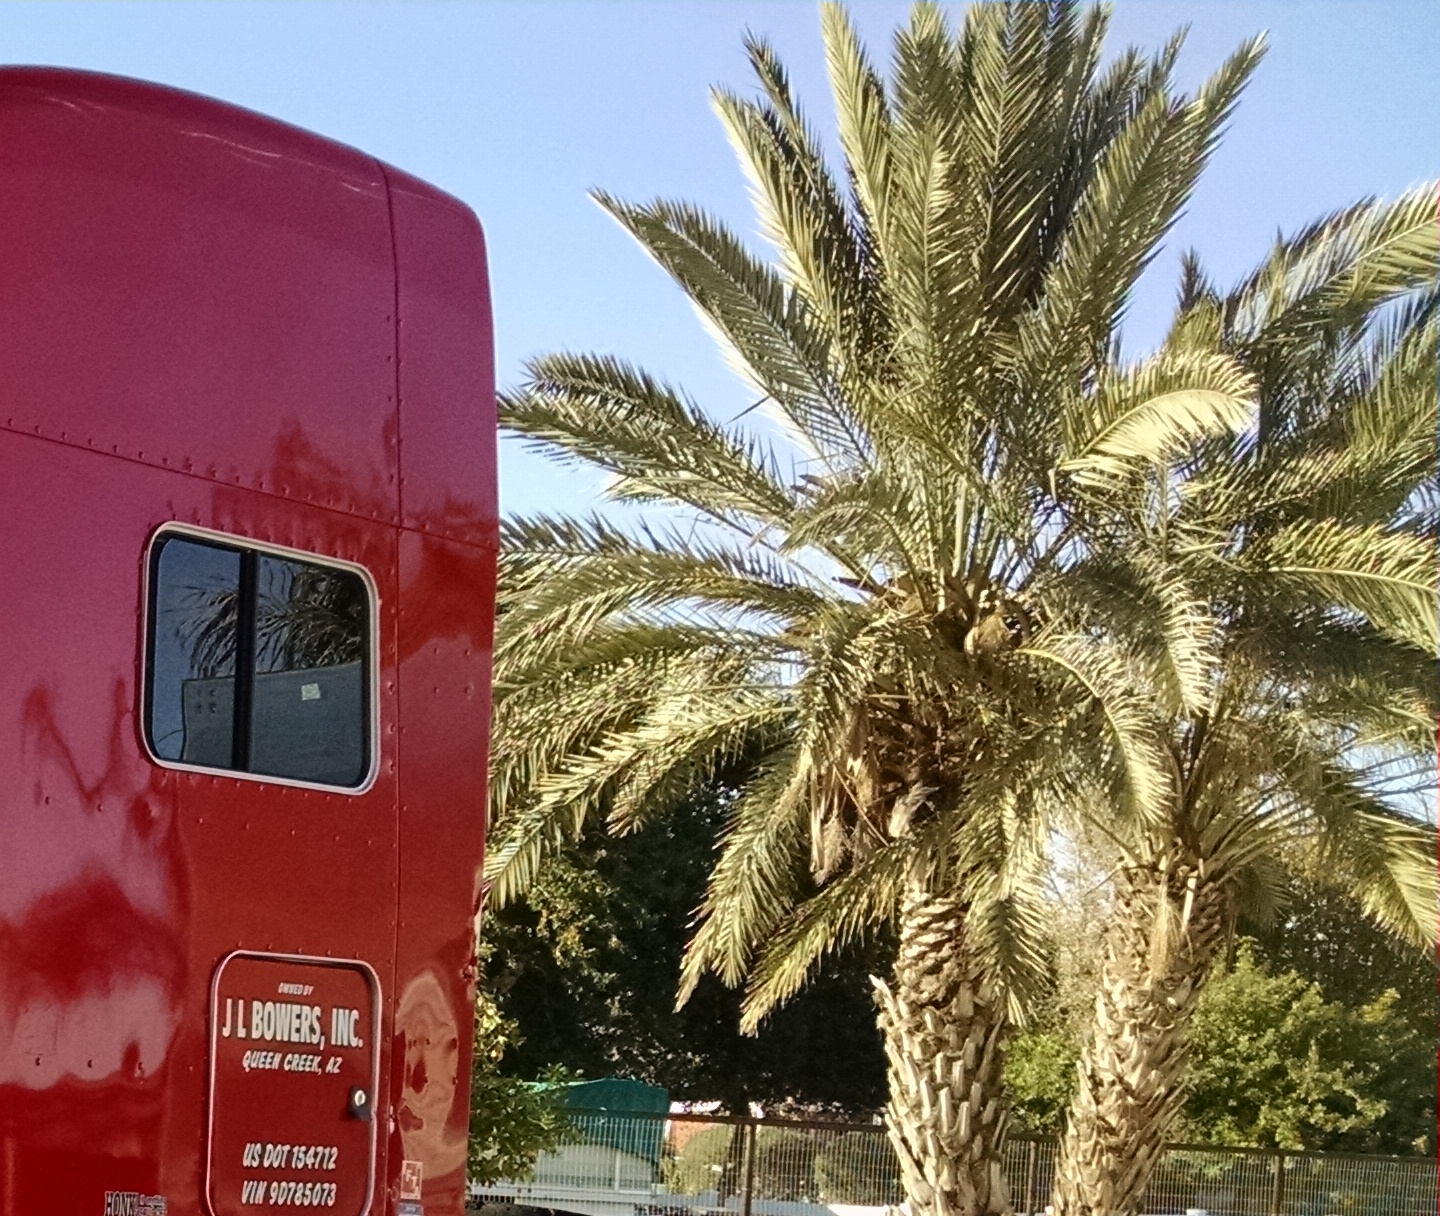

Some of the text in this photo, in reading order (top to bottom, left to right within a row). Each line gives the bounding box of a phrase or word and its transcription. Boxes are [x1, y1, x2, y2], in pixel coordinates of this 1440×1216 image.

[303, 984, 315, 996] BY
[222, 998, 364, 1050] J L BOWERS, INC.
[242, 1051, 344, 1076] QUEEN CREEK, AZ
[242, 1143, 339, 1170] US DOT 154712
[241, 1181, 267, 1205] VIN
